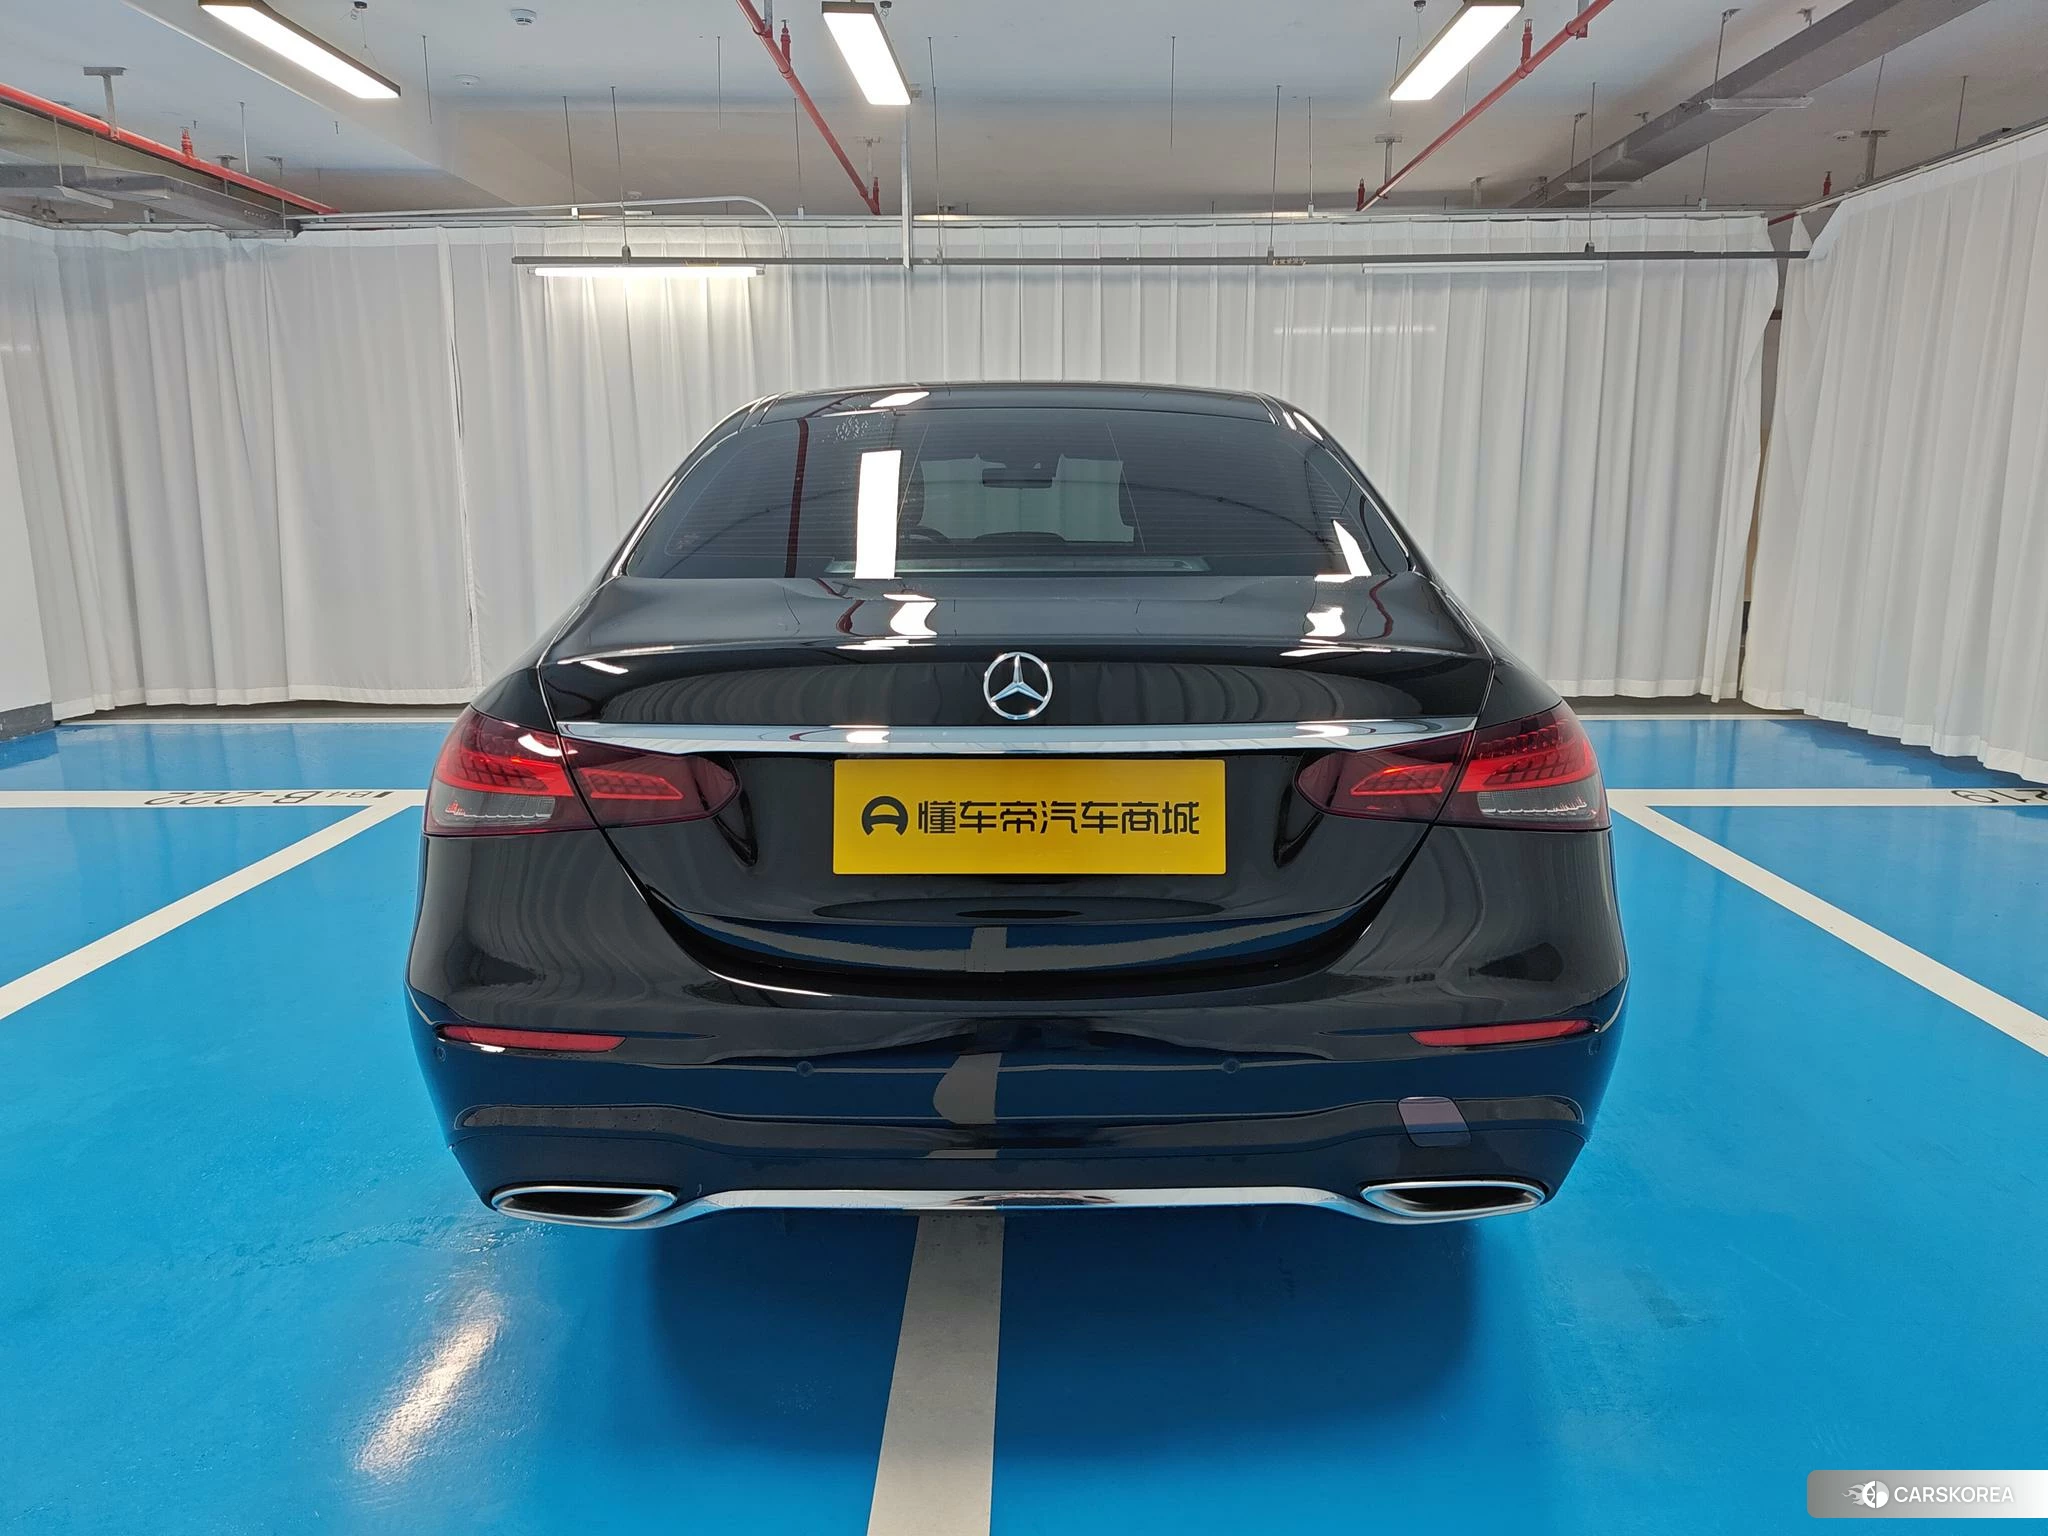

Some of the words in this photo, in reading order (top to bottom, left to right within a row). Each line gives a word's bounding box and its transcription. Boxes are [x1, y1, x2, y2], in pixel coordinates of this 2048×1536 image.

[144, 791, 323, 805] B-222
[918, 800, 1200, 835] 懂车帝汽车商城
